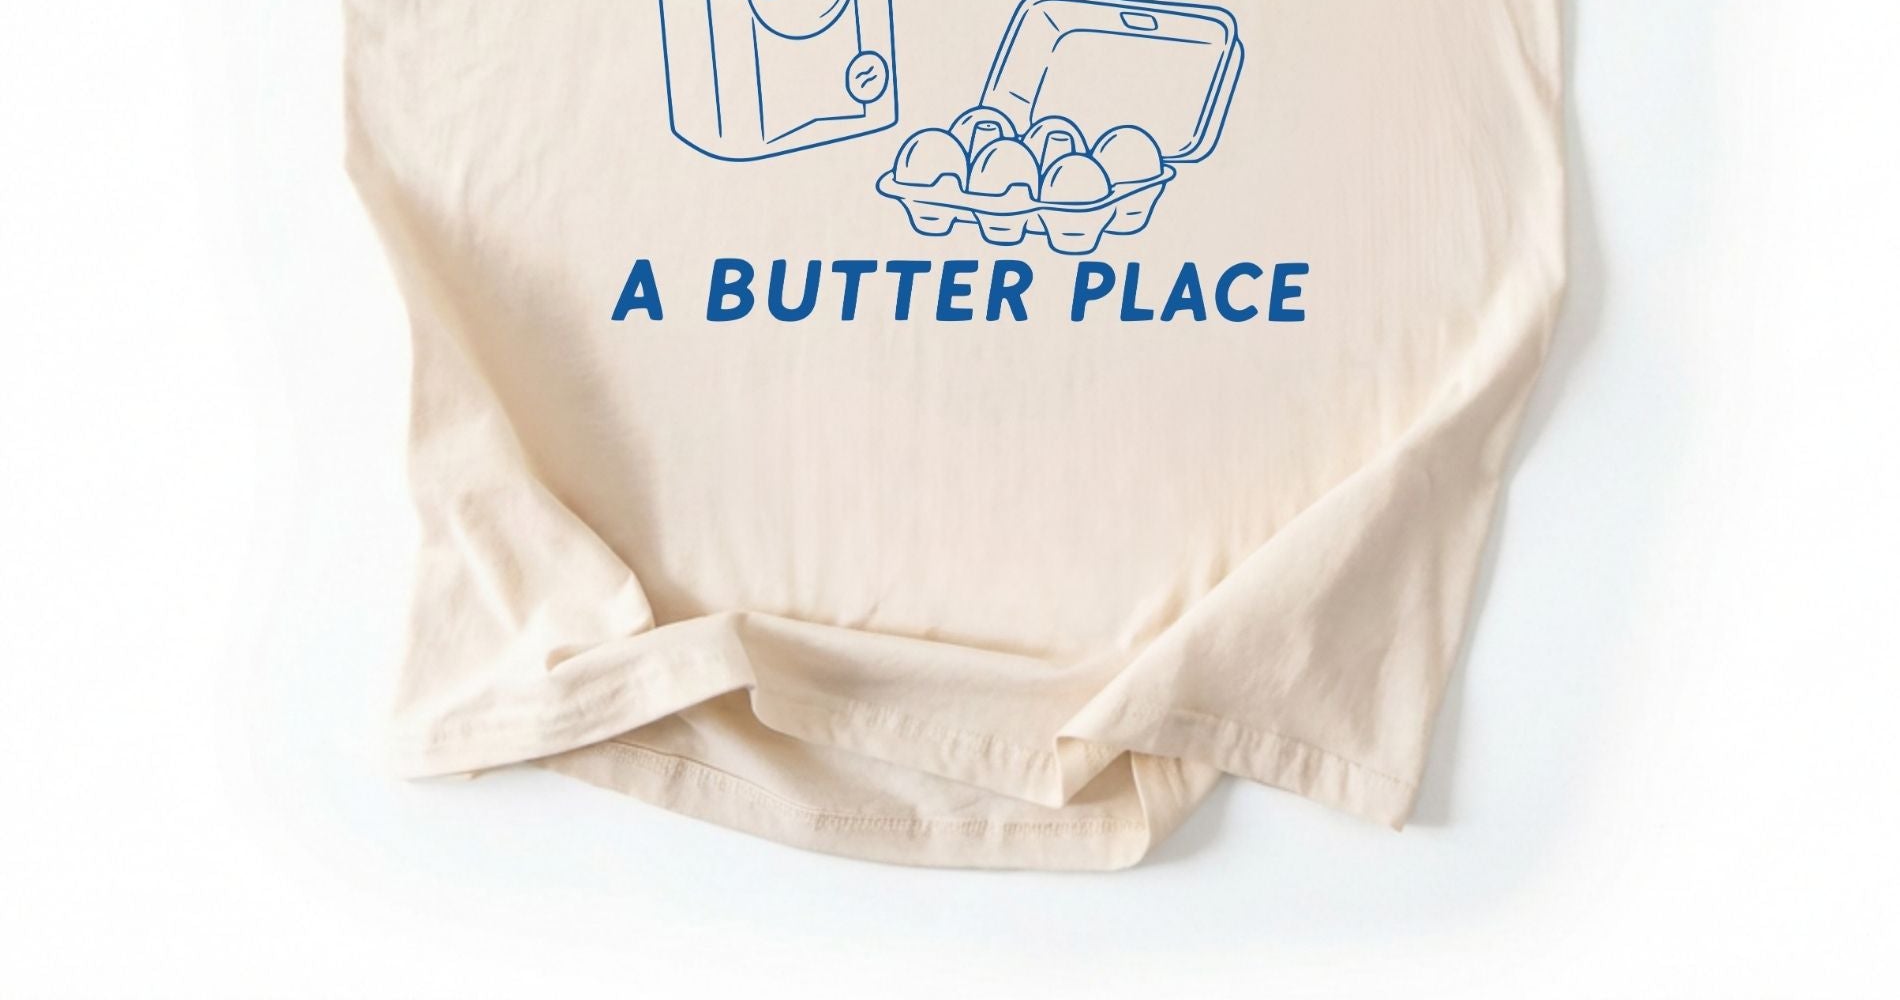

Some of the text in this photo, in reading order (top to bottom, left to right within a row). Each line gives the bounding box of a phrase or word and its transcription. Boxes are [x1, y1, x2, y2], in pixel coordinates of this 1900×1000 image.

[611, 258, 1310, 323] A BUTTER PLACE
